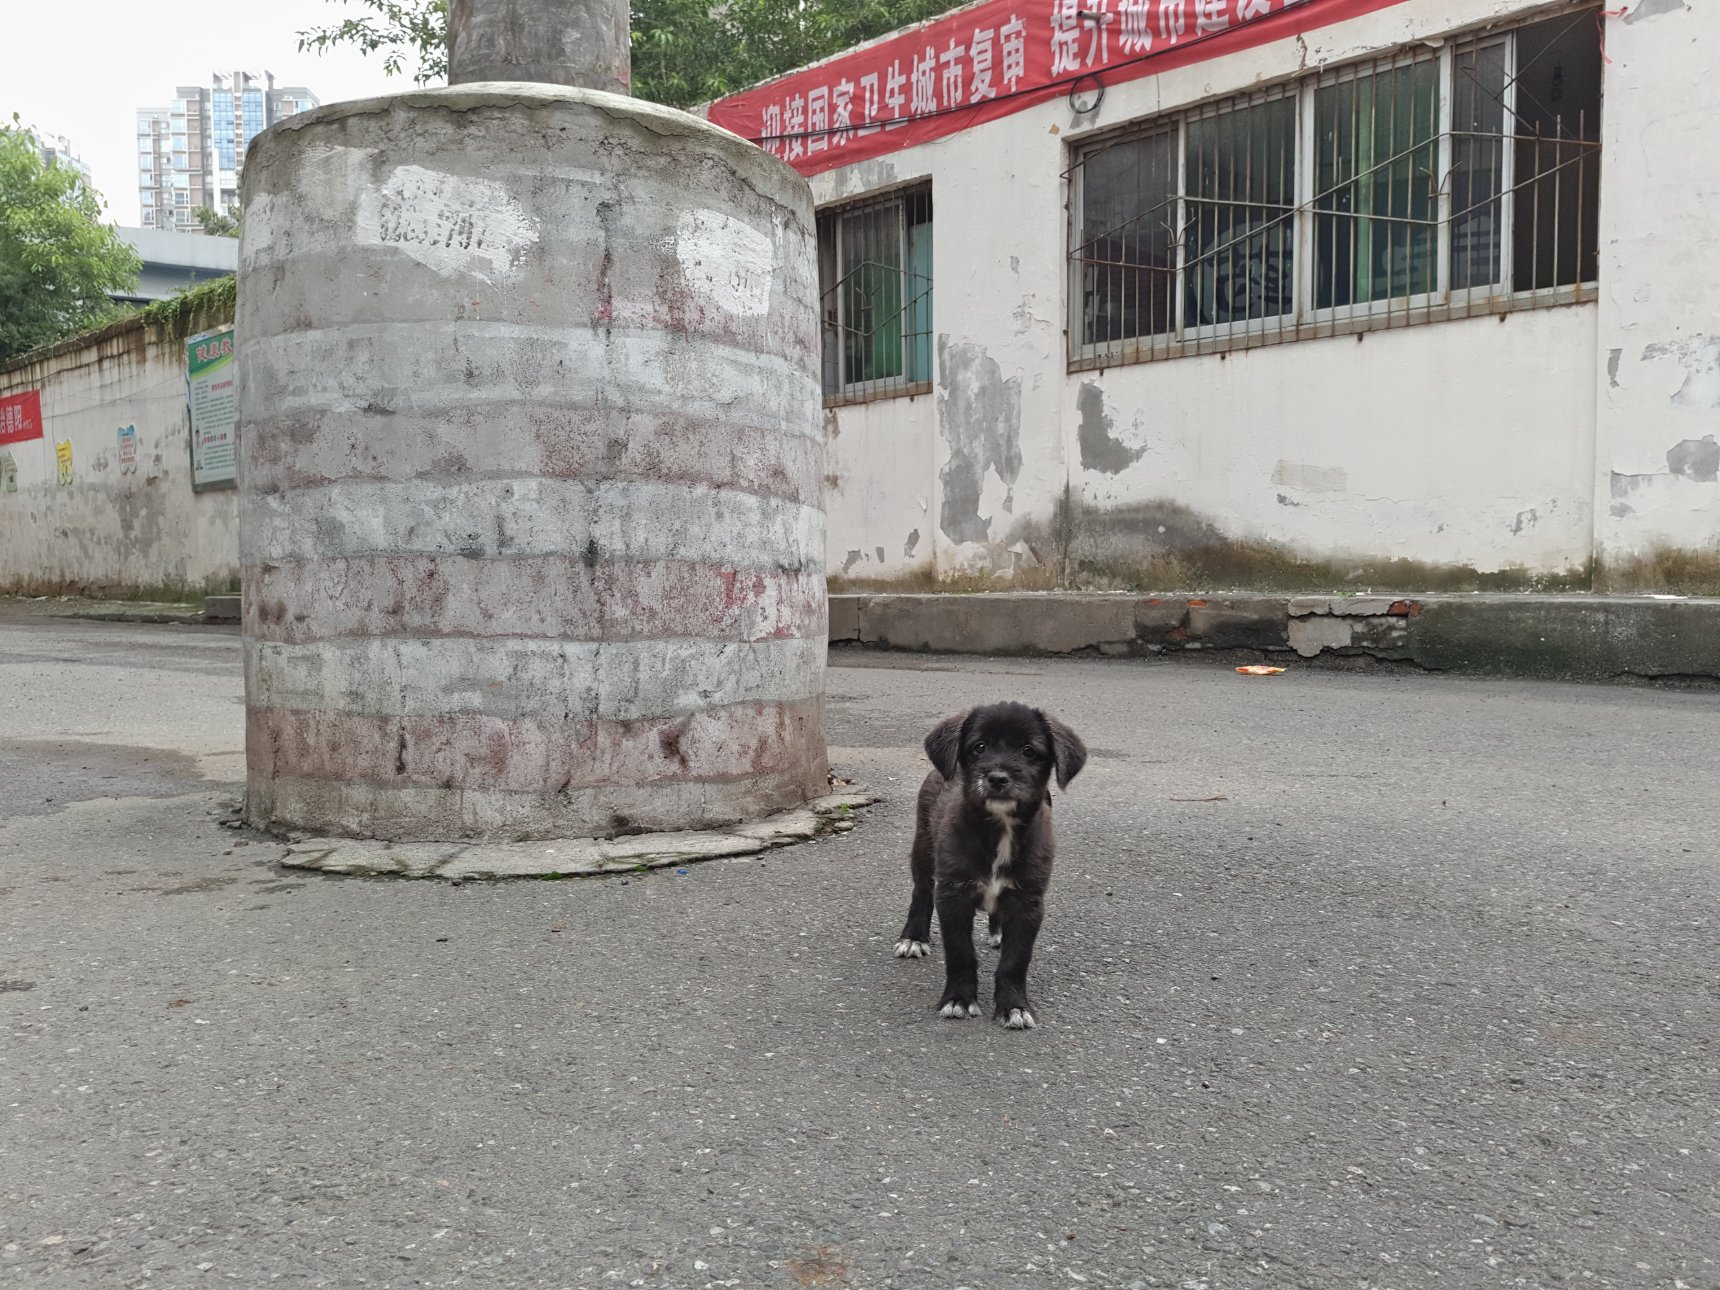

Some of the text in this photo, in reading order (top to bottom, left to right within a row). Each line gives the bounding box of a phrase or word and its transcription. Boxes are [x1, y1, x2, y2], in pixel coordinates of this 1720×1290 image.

[760, 0, 1301, 162] 迎接国家卫生城市复审 提升城市
